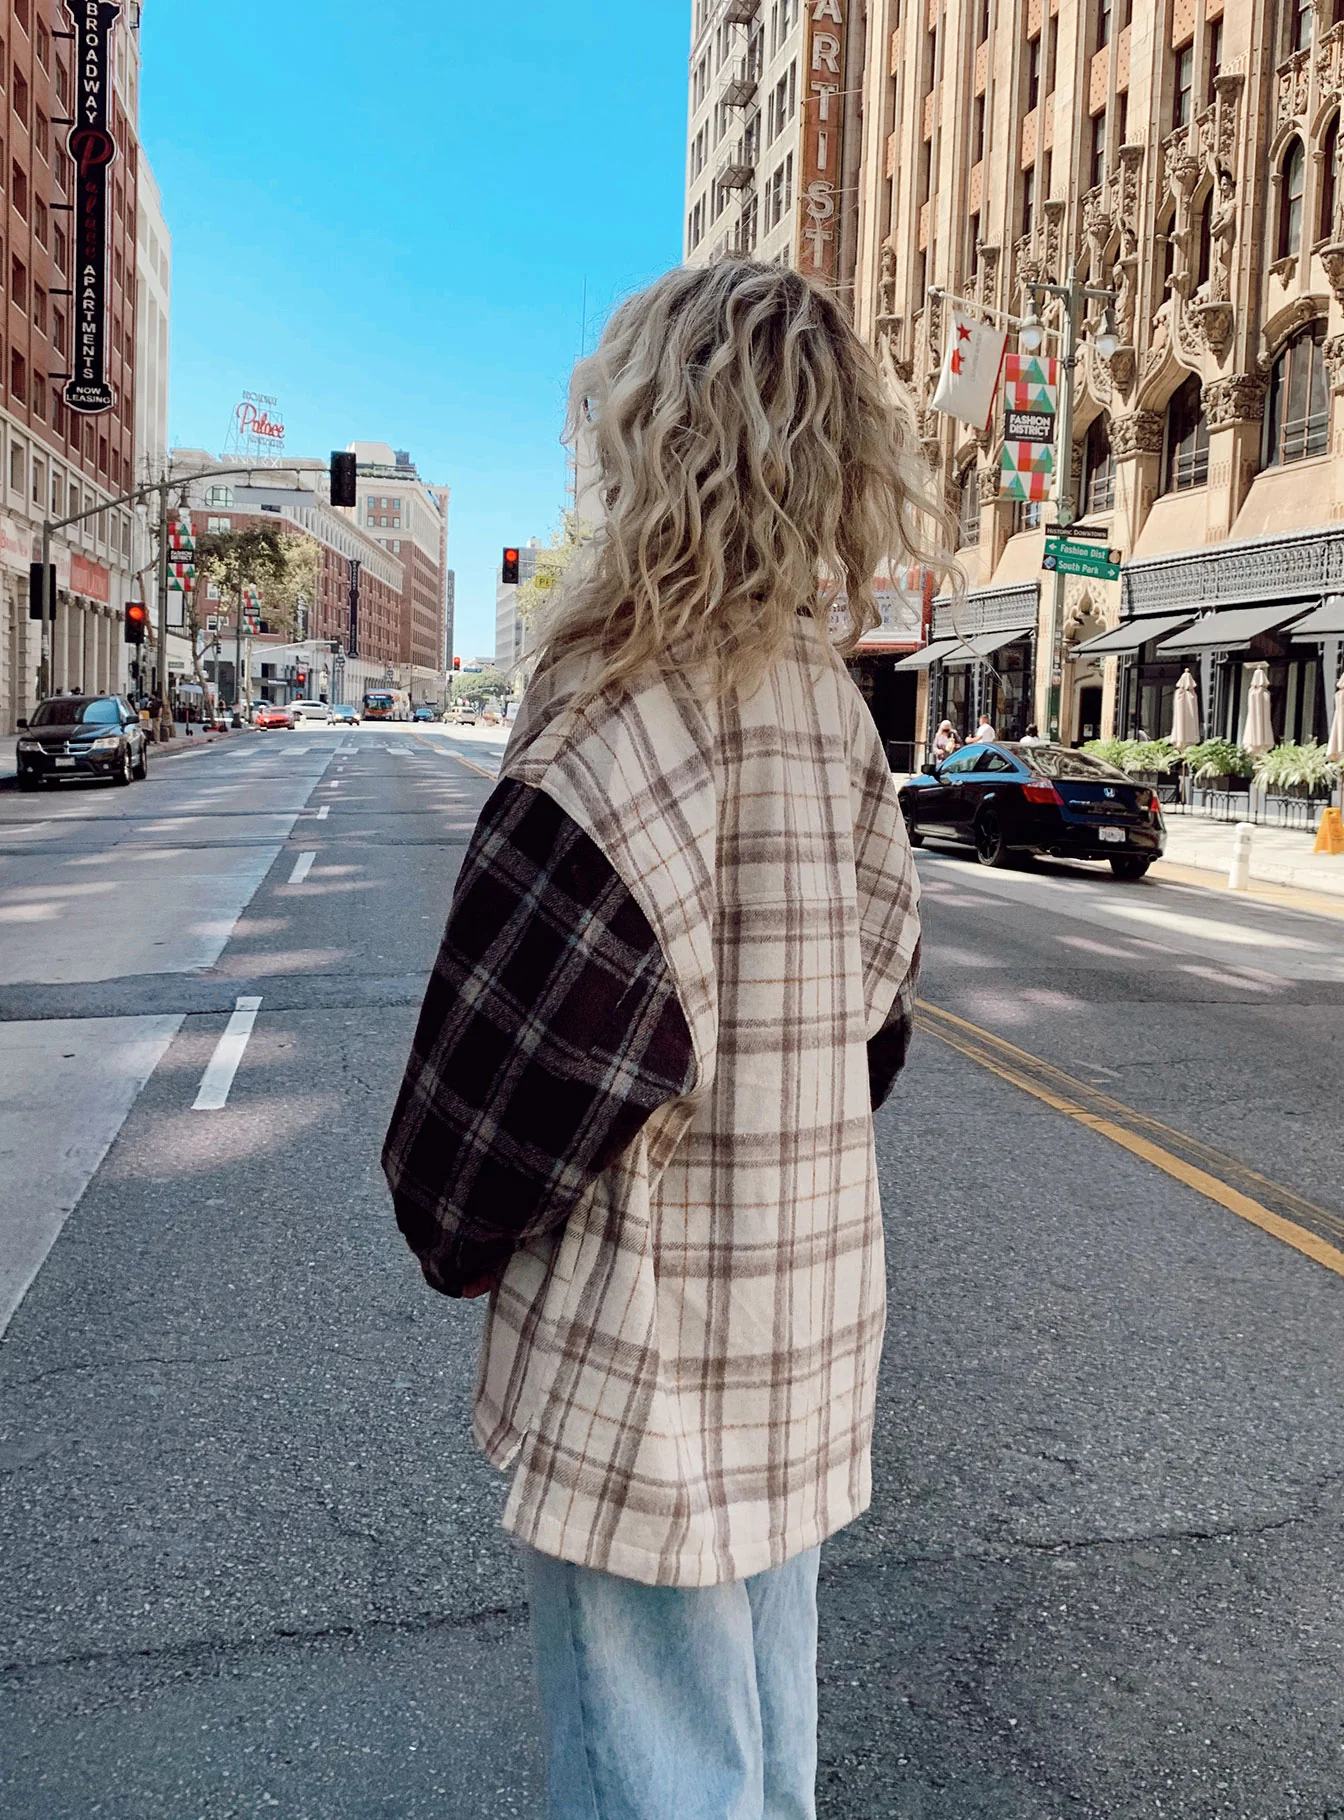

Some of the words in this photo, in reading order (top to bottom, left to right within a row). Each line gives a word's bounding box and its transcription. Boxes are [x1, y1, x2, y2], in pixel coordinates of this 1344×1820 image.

[84, 2, 100, 124] BROADWAY
[805, 0, 843, 268] ARTIST
[81, 265, 97, 379] APARTMENTS
[76, 386, 101, 395] NOW
[66, 393, 111, 404] LEASING
[236, 402, 285, 439] Palace
[1009, 414, 1051, 426] FASHION
[1009, 423, 1050, 437] DISTRICT
[1060, 544, 1089, 557] Fashion
[1090, 549, 1106, 559] Dist
[1058, 560, 1080, 572] South
[1082, 564, 1099, 574] Park
